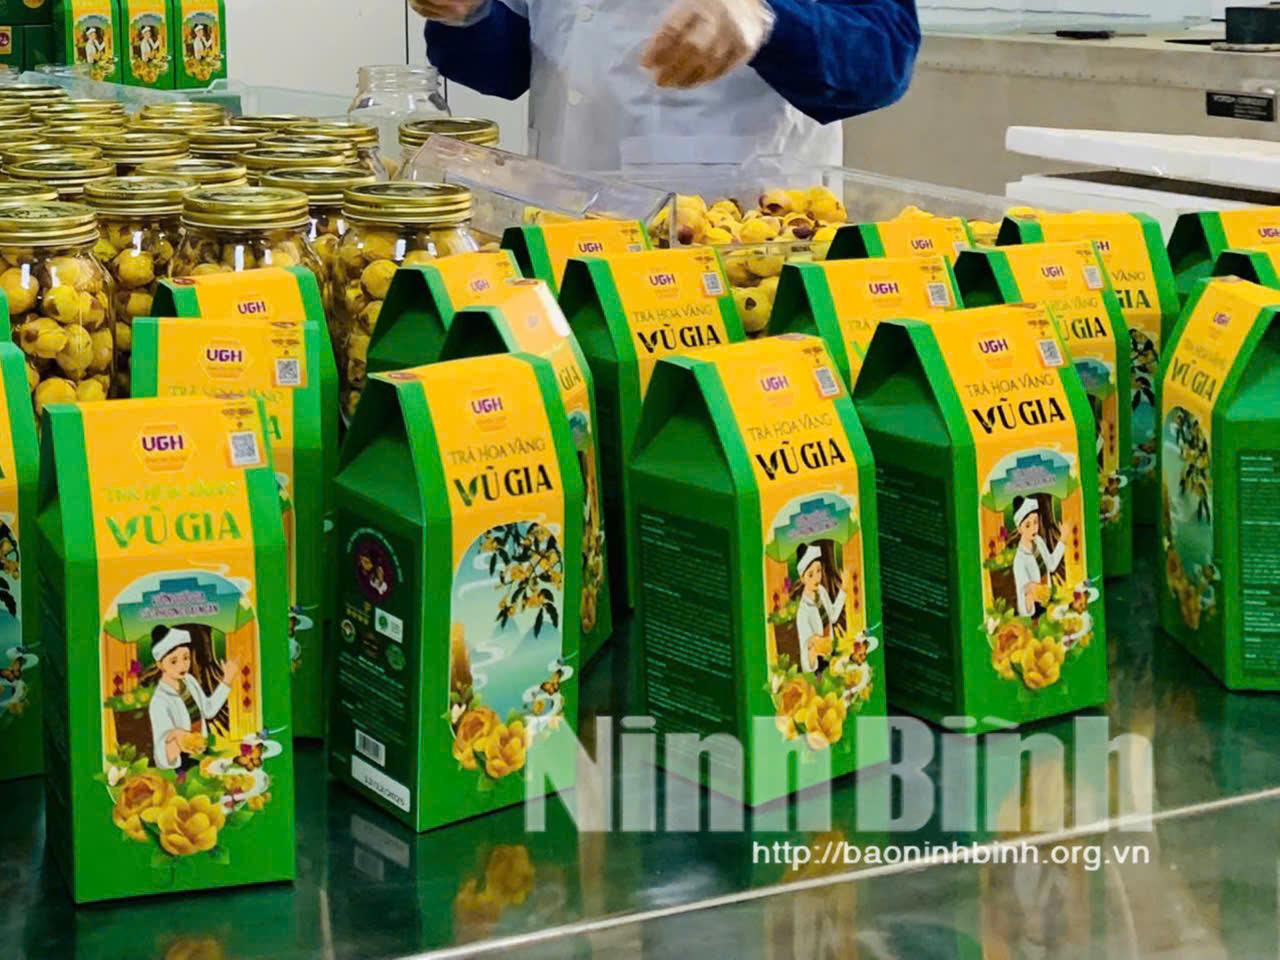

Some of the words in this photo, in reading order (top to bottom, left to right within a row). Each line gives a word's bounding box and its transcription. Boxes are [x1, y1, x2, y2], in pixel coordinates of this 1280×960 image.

[679, 325, 722, 348] GIA
[1072, 317, 1107, 340] GIA
[1019, 397, 1066, 426] GIA
[142, 435, 184, 451] UGH
[801, 438, 846, 470] GIA
[504, 464, 553, 496] GIA
[175, 509, 242, 543] GIA
